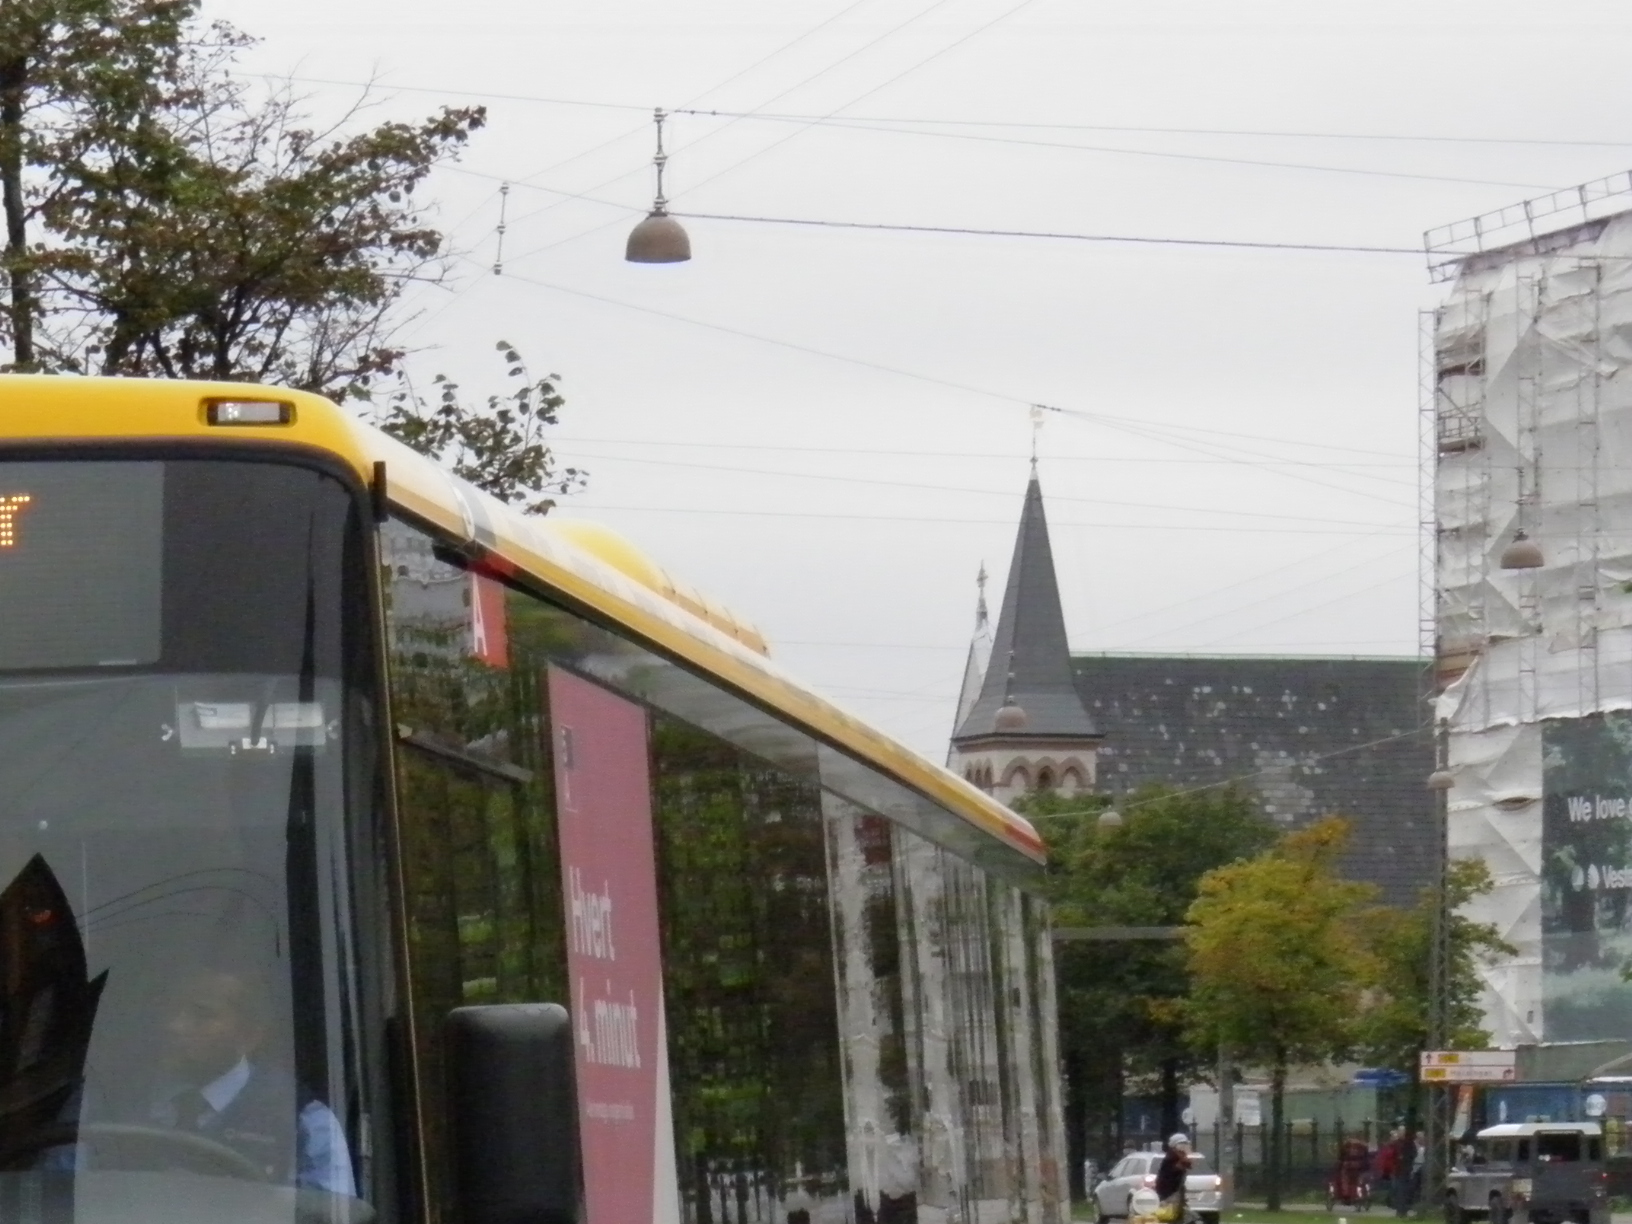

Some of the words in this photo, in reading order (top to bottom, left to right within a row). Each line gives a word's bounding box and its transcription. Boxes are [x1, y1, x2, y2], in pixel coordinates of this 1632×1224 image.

[1567, 796, 1592, 822] We
[1595, 794, 1625, 820] love
[569, 865, 615, 961] Hvert
[594, 979, 641, 1069] minut
